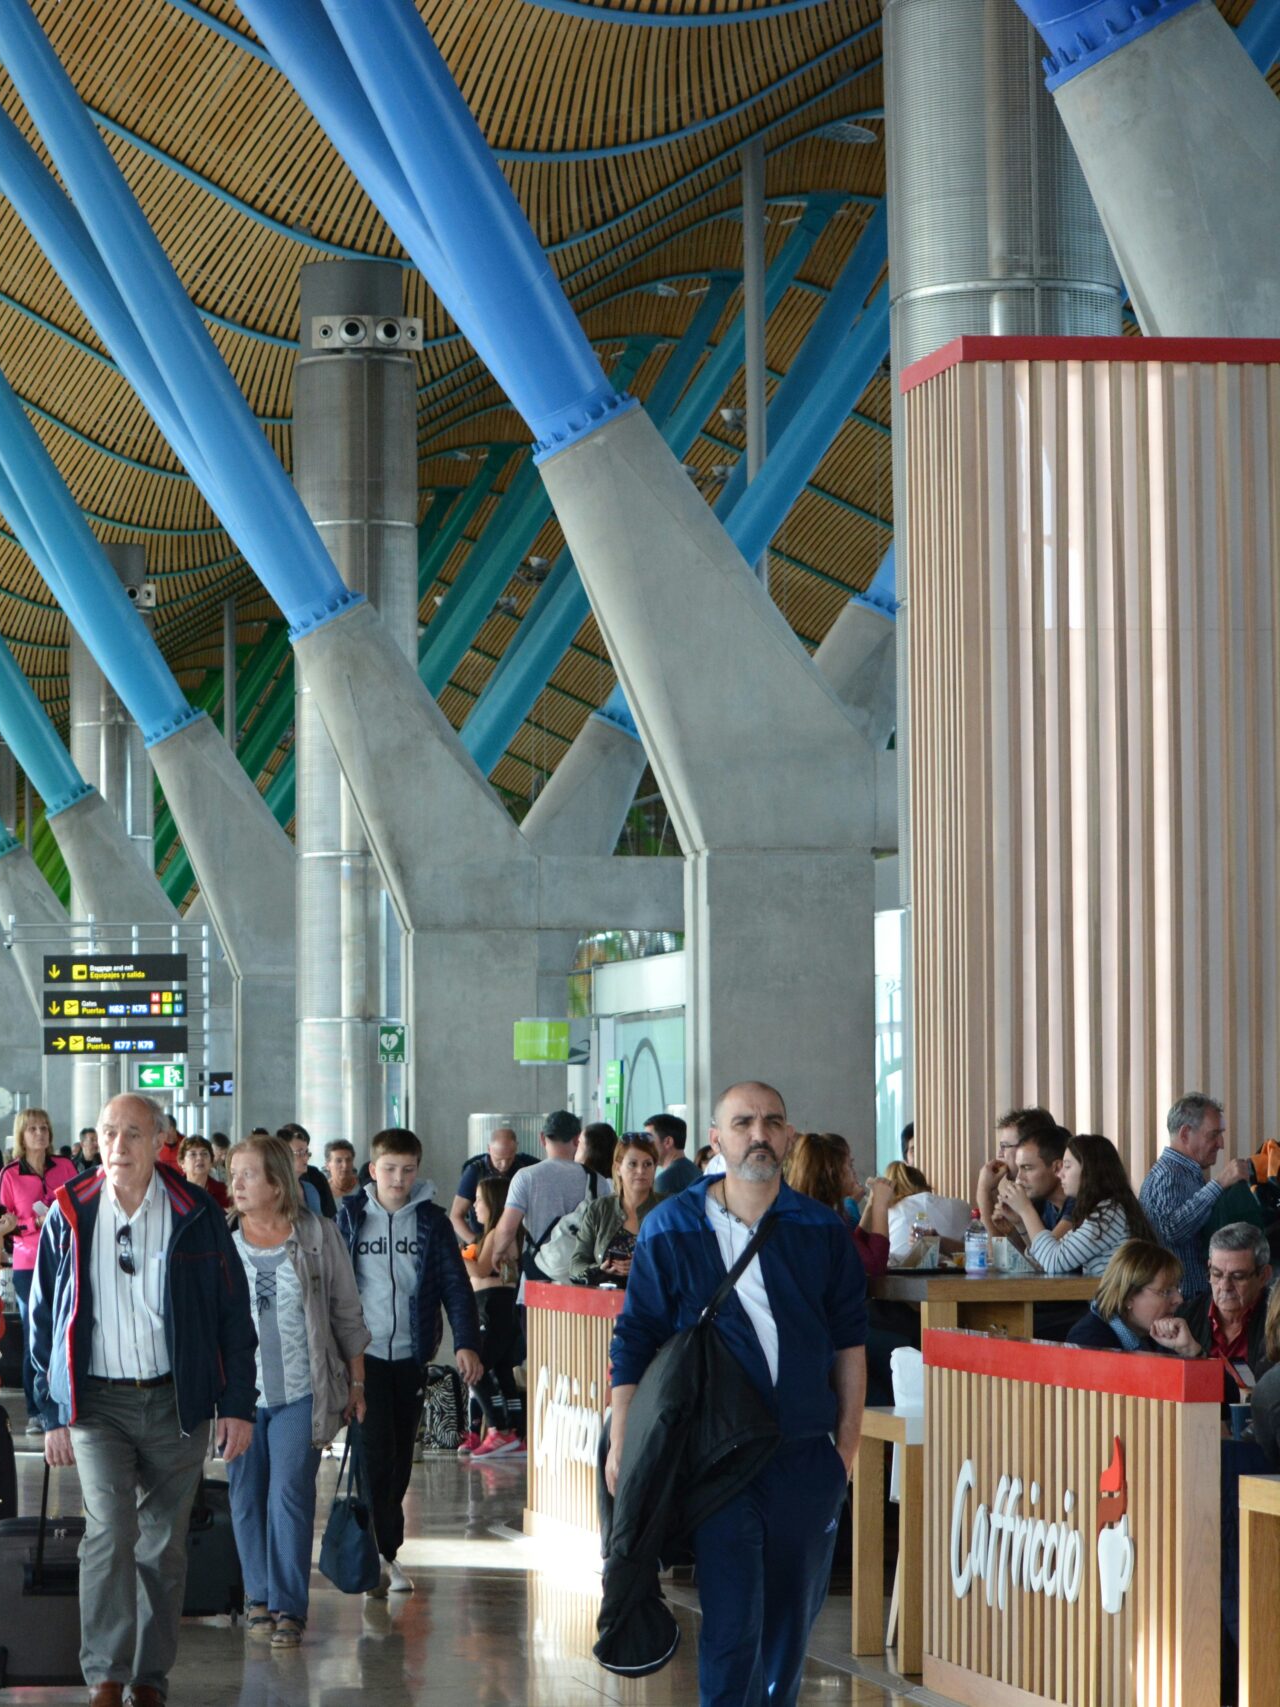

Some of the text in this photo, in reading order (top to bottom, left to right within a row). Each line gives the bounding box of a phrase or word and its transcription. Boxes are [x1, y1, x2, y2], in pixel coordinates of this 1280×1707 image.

[90, 971, 120, 979] Equipajes
[127, 971, 145, 979] salida
[81, 1007, 106, 1015] Puertas
[108, 1004, 125, 1014] K62
[131, 1004, 148, 1014] K75
[86, 1042, 111, 1050] Puertas
[114, 1040, 131, 1050] K77
[137, 1040, 154, 1050] K79
[380, 1054, 404, 1062] DEA
[951, 1459, 1083, 1611] Caffriccio
